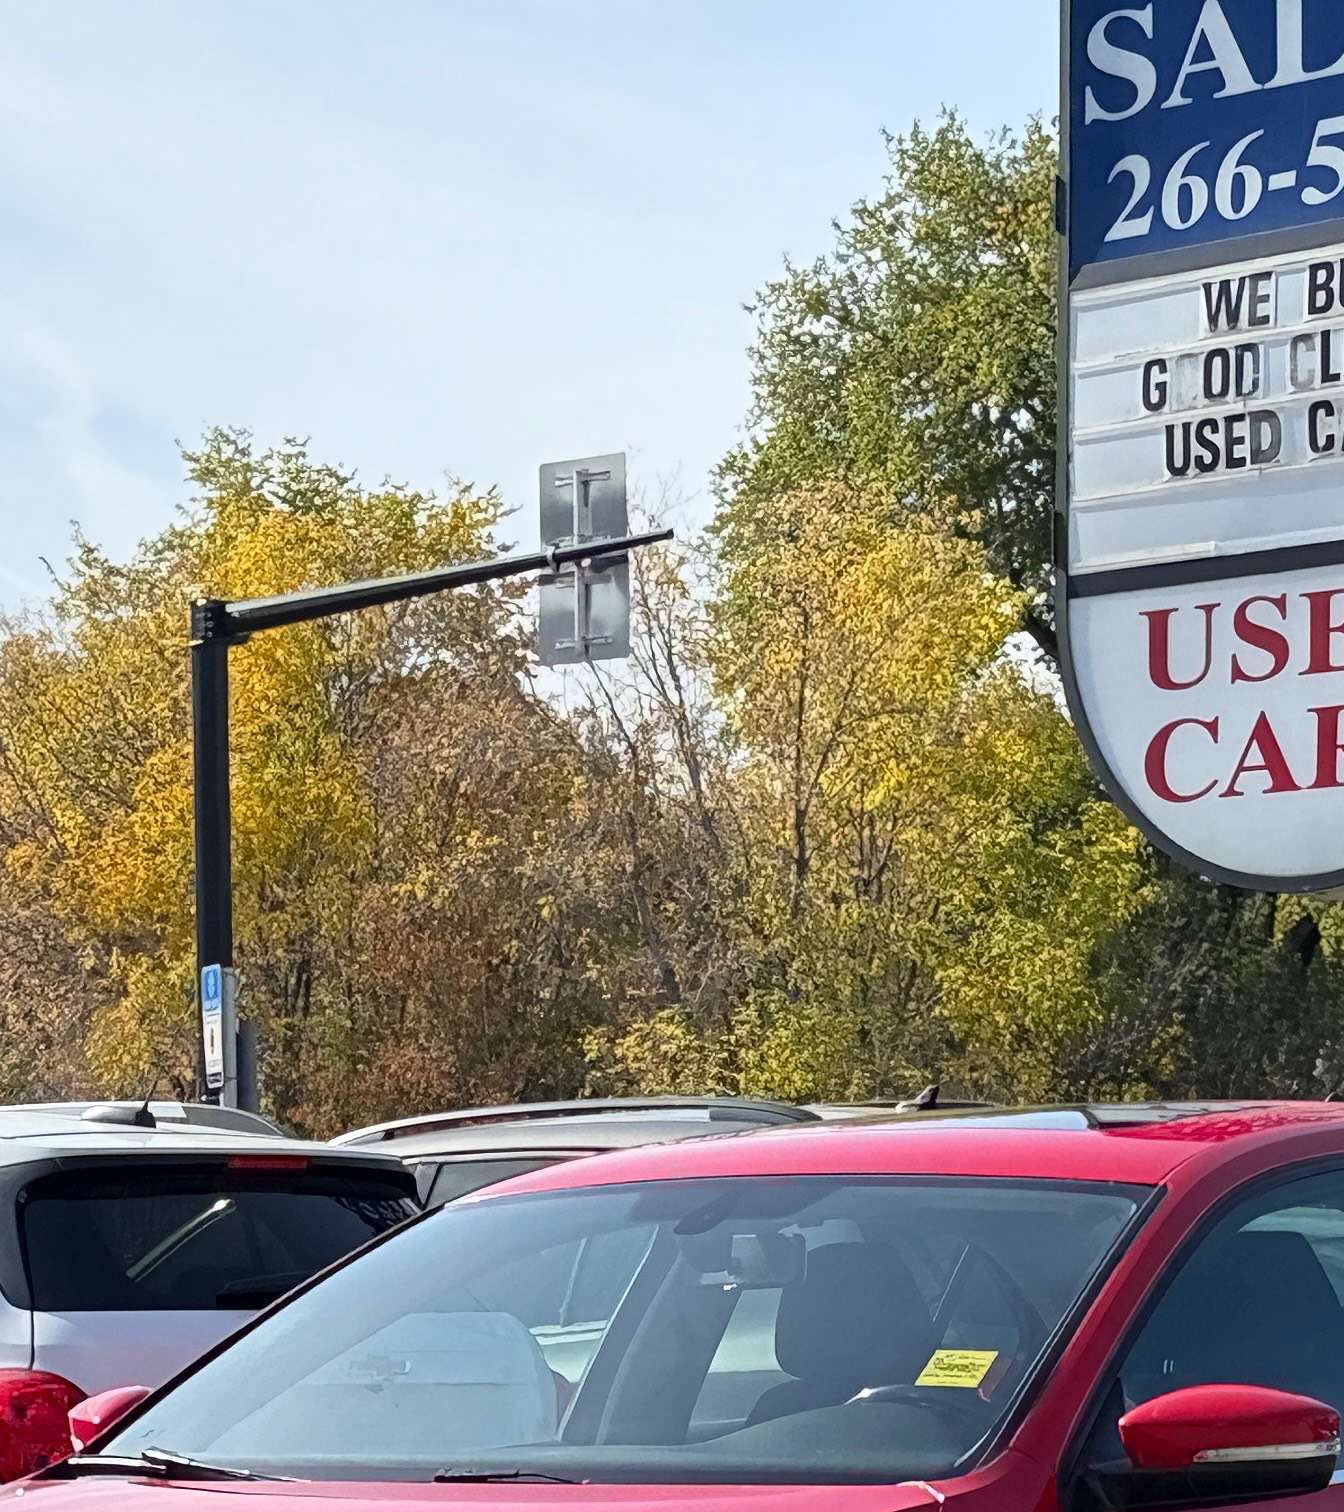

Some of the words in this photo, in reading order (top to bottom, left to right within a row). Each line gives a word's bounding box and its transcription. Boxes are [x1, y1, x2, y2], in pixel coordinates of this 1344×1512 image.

[1202, 270, 1274, 333] WE
[1142, 342, 1260, 413] GOD
[1164, 408, 1282, 477] USED
